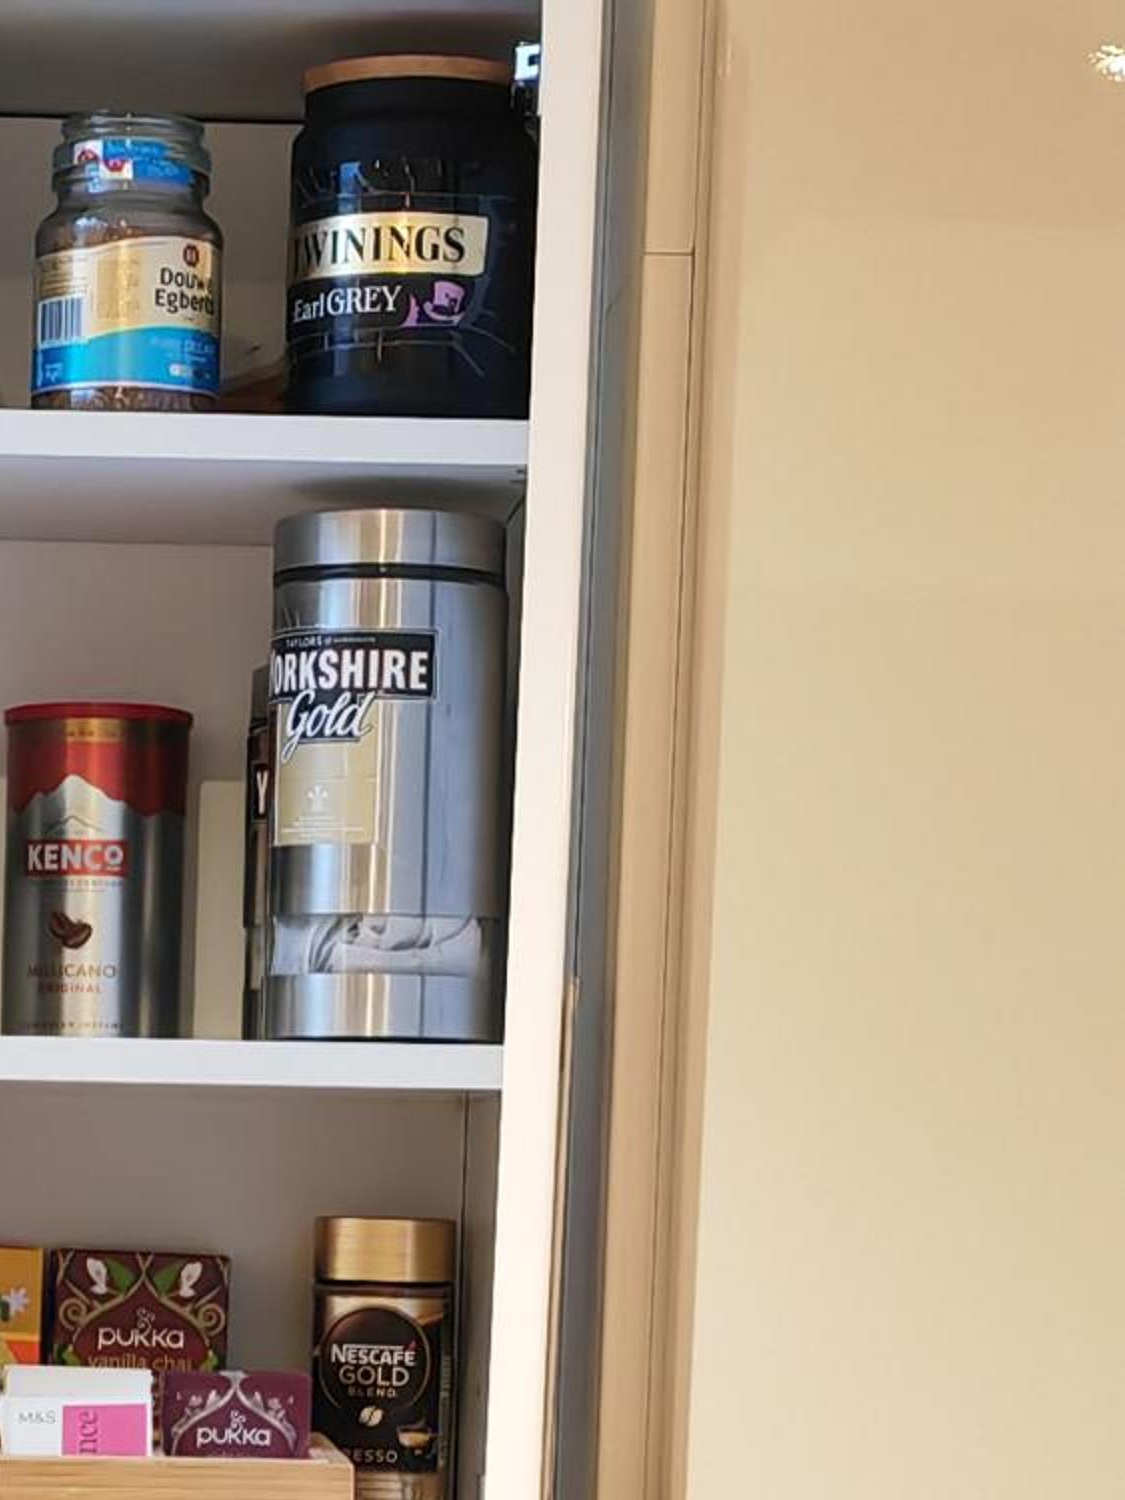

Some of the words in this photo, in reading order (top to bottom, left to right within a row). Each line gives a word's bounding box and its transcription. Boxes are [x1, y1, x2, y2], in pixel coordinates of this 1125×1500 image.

[294, 292, 325, 323] Earl
[326, 285, 402, 317] GREY
[282, 689, 374, 763] Gold
[28, 843, 124, 872] KENCO
[97, 1327, 184, 1351] pukka
[87, 1353, 145, 1368] vanilla
[339, 1365, 410, 1387] GOLD
[348, 1386, 397, 1398] BLEND
[197, 1427, 272, 1449] pukka
